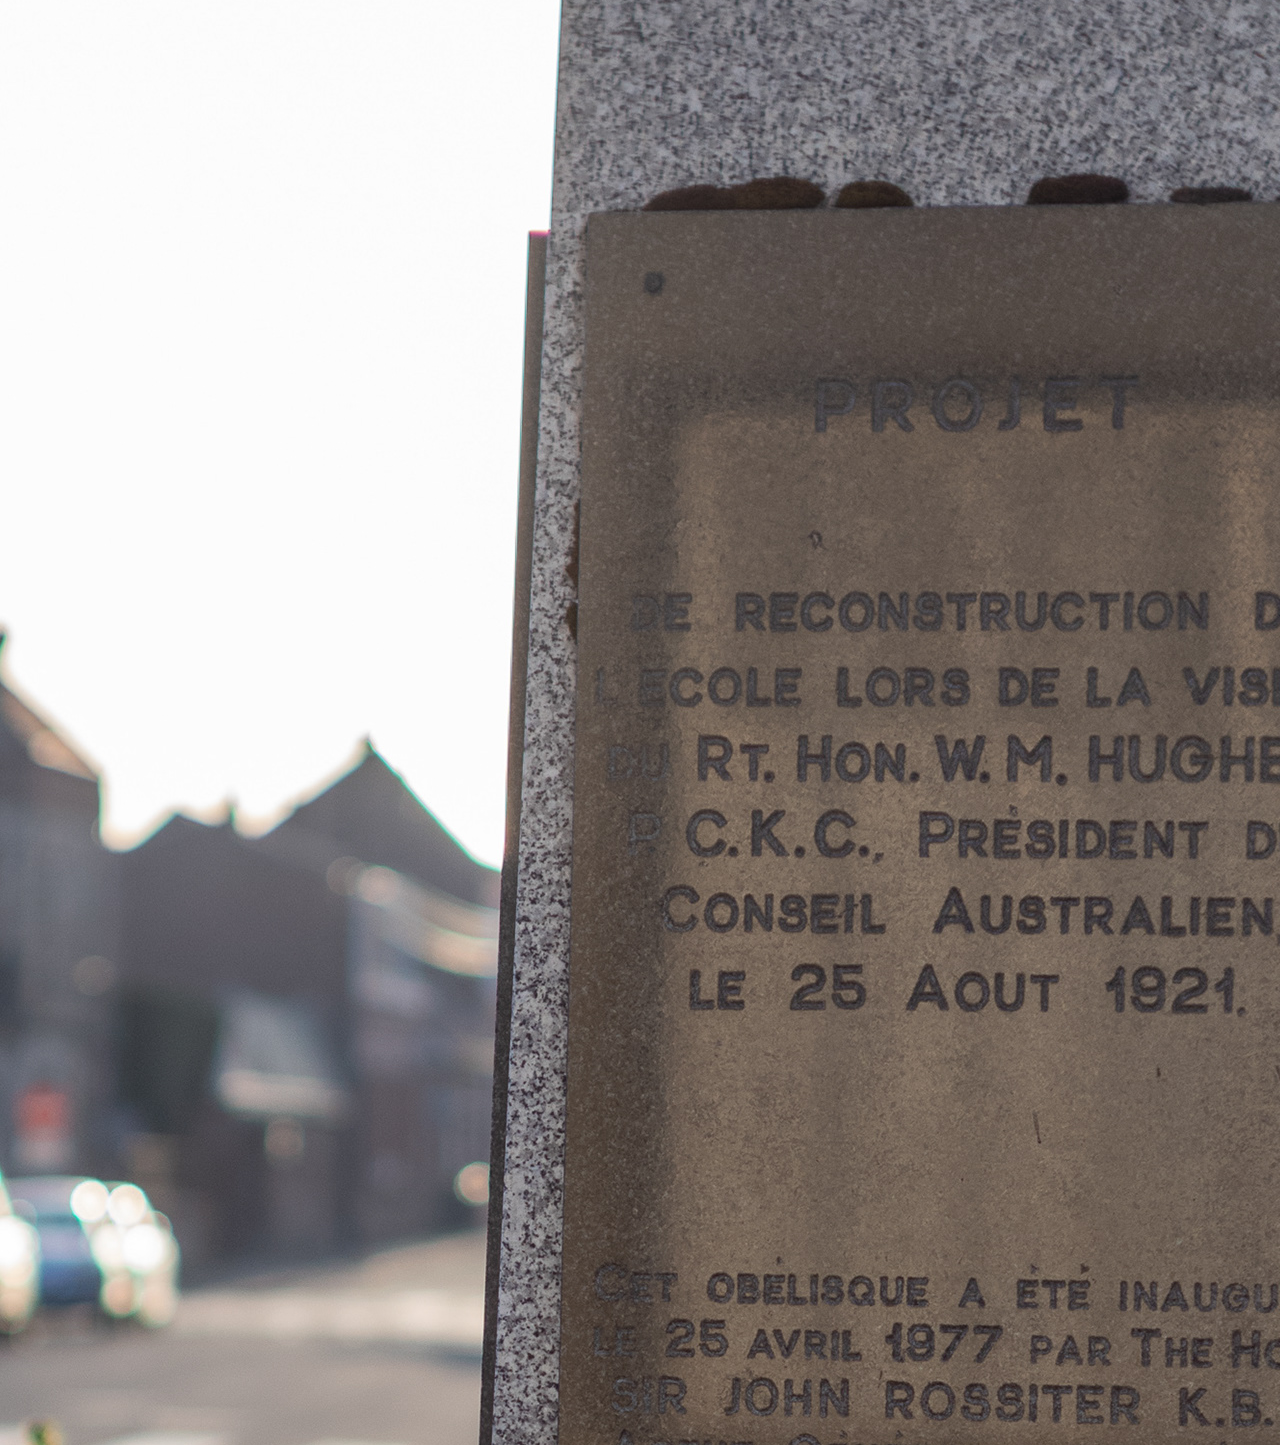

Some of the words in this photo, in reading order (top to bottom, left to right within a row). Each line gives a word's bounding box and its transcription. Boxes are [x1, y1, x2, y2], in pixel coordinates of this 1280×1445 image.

[814, 373, 1140, 434] PROJET
[629, 590, 693, 633] DE
[734, 590, 1210, 633] RECONSTRUCTION
[835, 666, 971, 708] LORS
[997, 666, 1061, 708] DE
[1085, 666, 1151, 708] LA
[688, 968, 747, 1012] LE
[788, 963, 868, 1012] 25
[957, 1276, 987, 1310] A
[664, 1318, 730, 1359] 25
[746, 1327, 863, 1362] AVRIL
[884, 1321, 1004, 1365] 1977
[1029, 1333, 1113, 1368] PAR
[611, 1374, 689, 1415] SIR
[723, 1376, 851, 1419] JOHN
[883, 1378, 1142, 1426] ROSSITER
